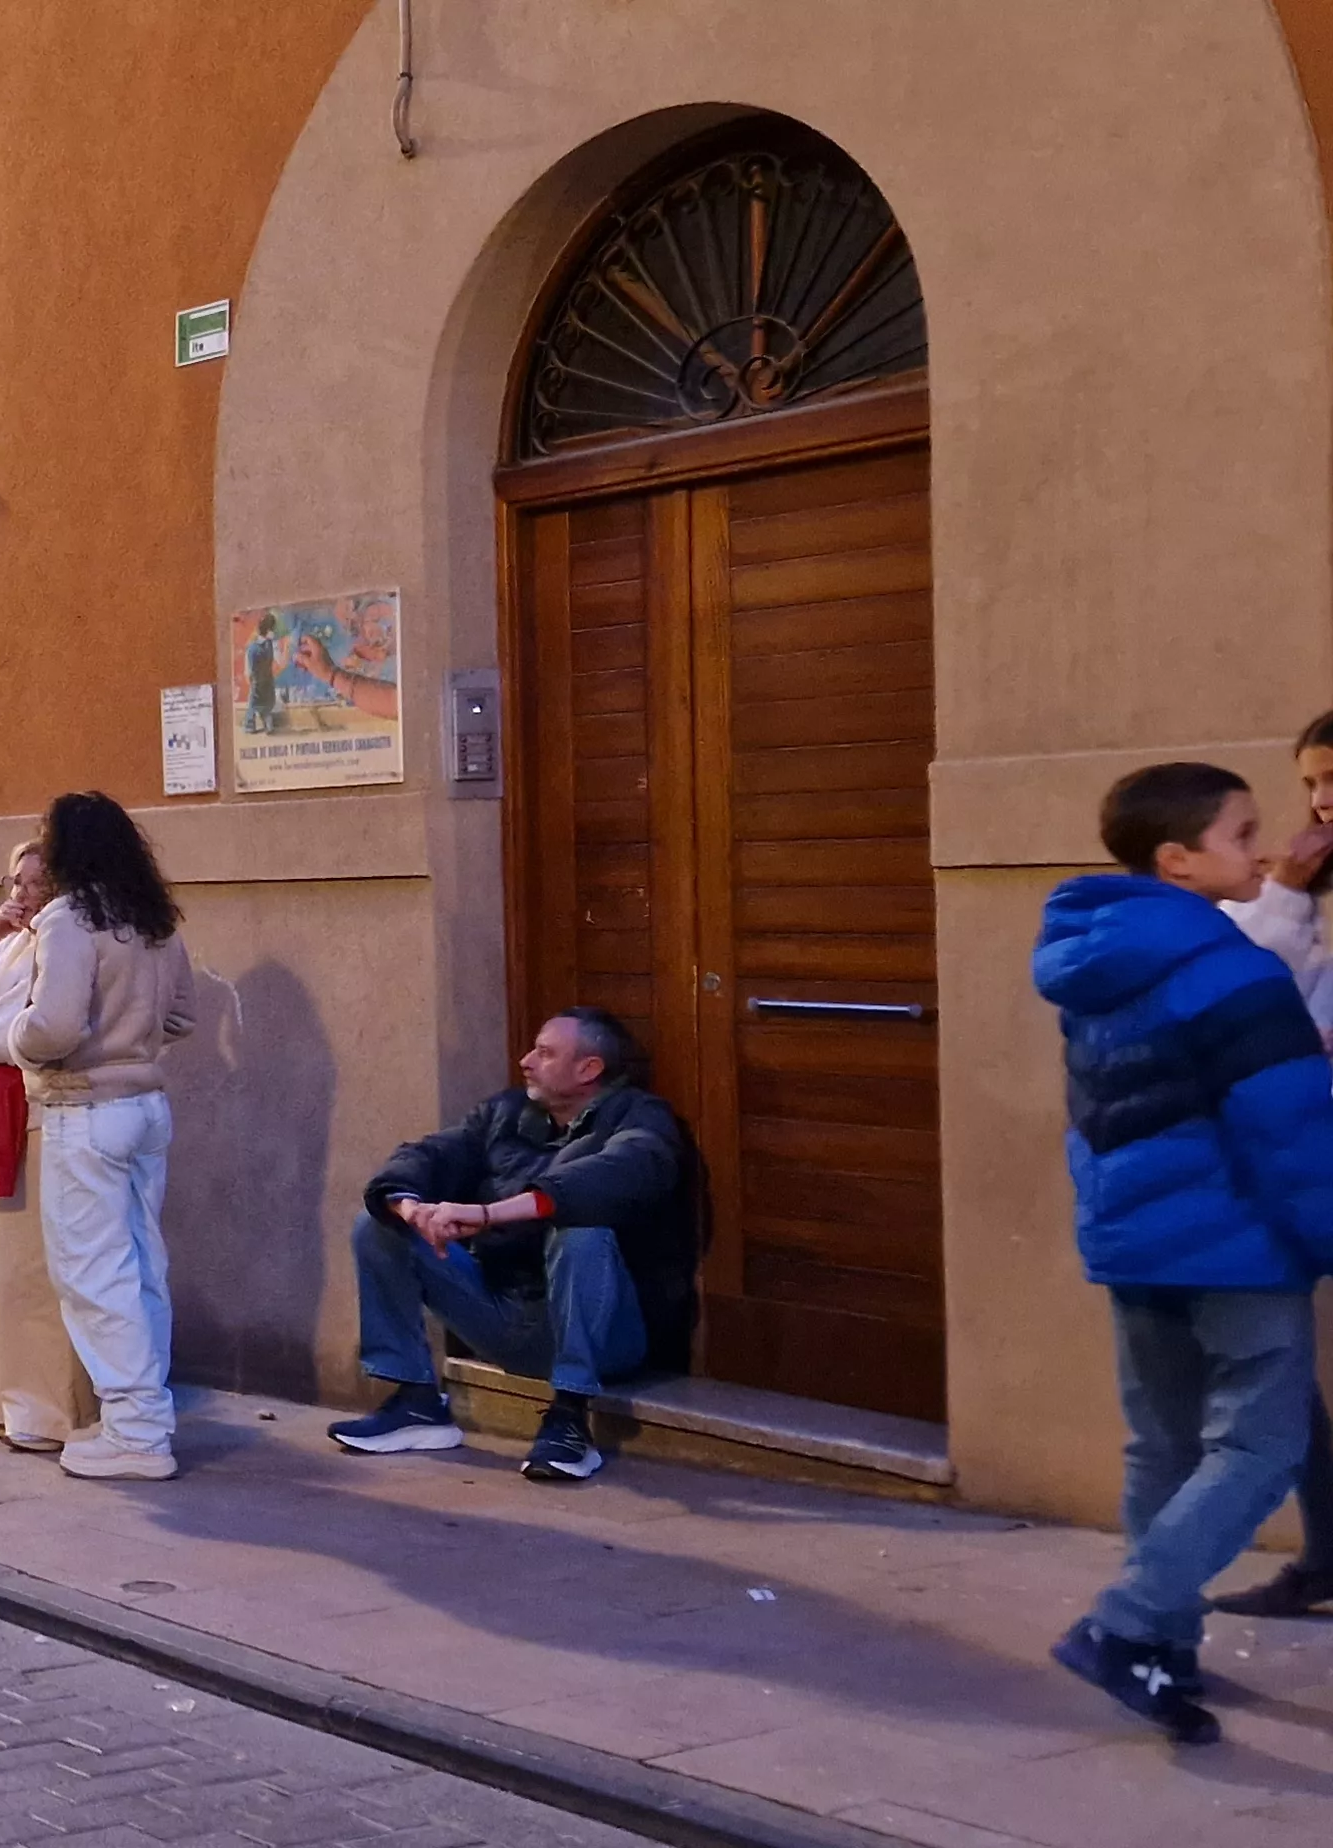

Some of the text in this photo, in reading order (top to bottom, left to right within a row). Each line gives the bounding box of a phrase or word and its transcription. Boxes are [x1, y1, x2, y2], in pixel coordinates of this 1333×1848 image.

[239, 747, 258, 760] TALLER
[260, 746, 267, 759] DE
[296, 742, 320, 756] PINTURA
